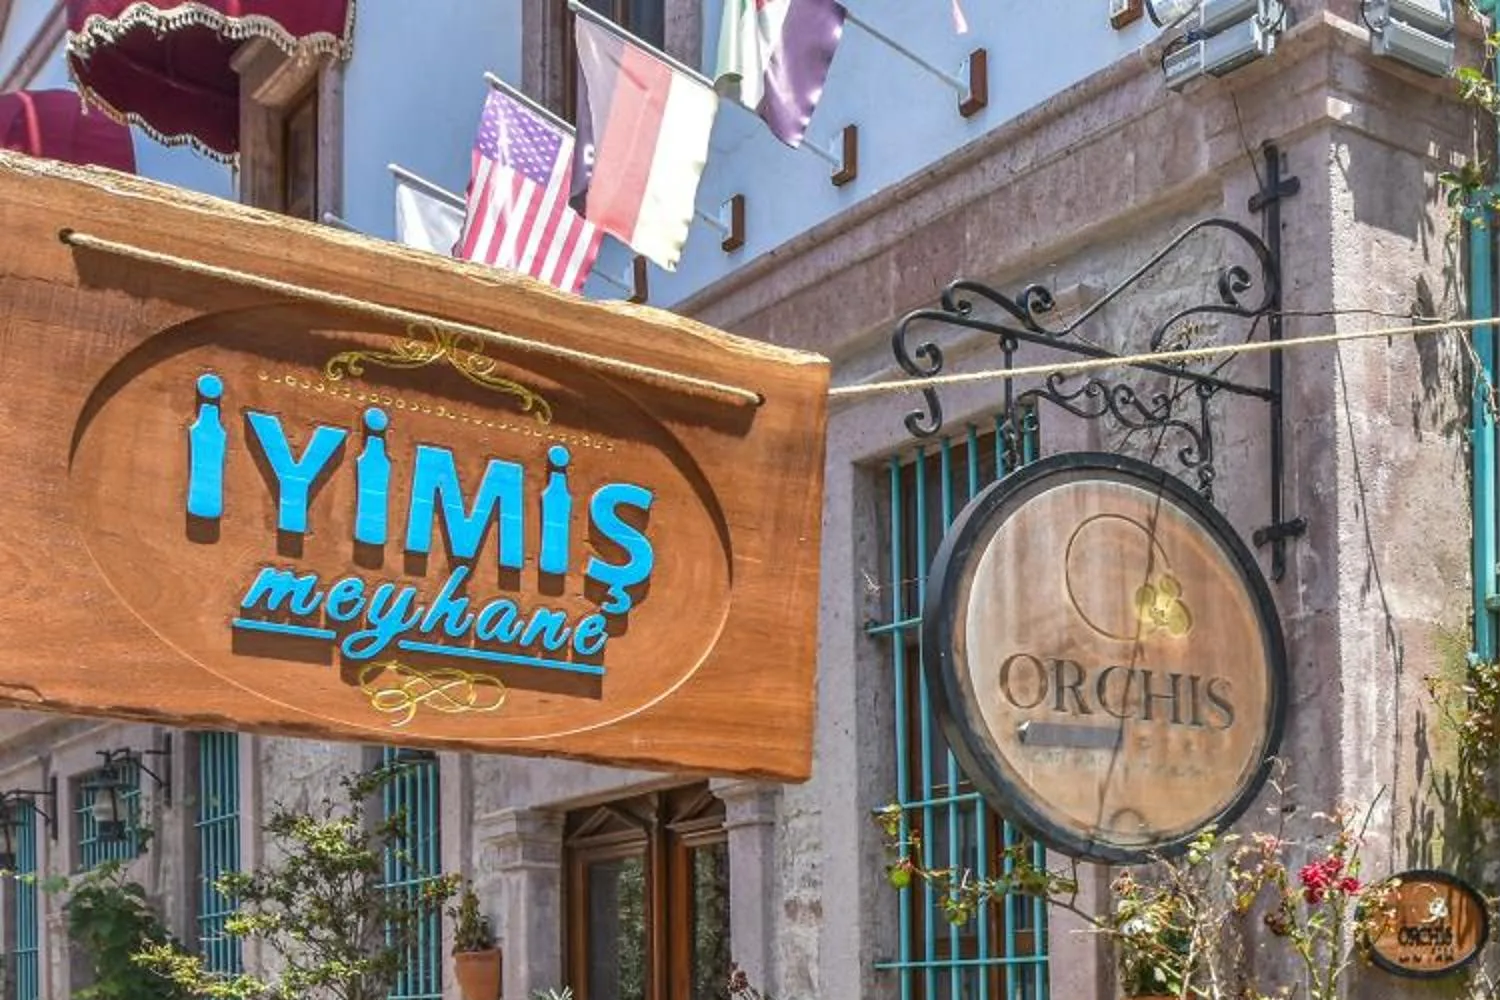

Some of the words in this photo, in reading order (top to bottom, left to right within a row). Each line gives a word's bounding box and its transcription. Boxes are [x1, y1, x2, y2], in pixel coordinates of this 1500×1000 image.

[241, 565, 608, 660] meyhane
[999, 653, 1235, 730] ORCHIS
[1398, 927, 1453, 946] ORCHIS
